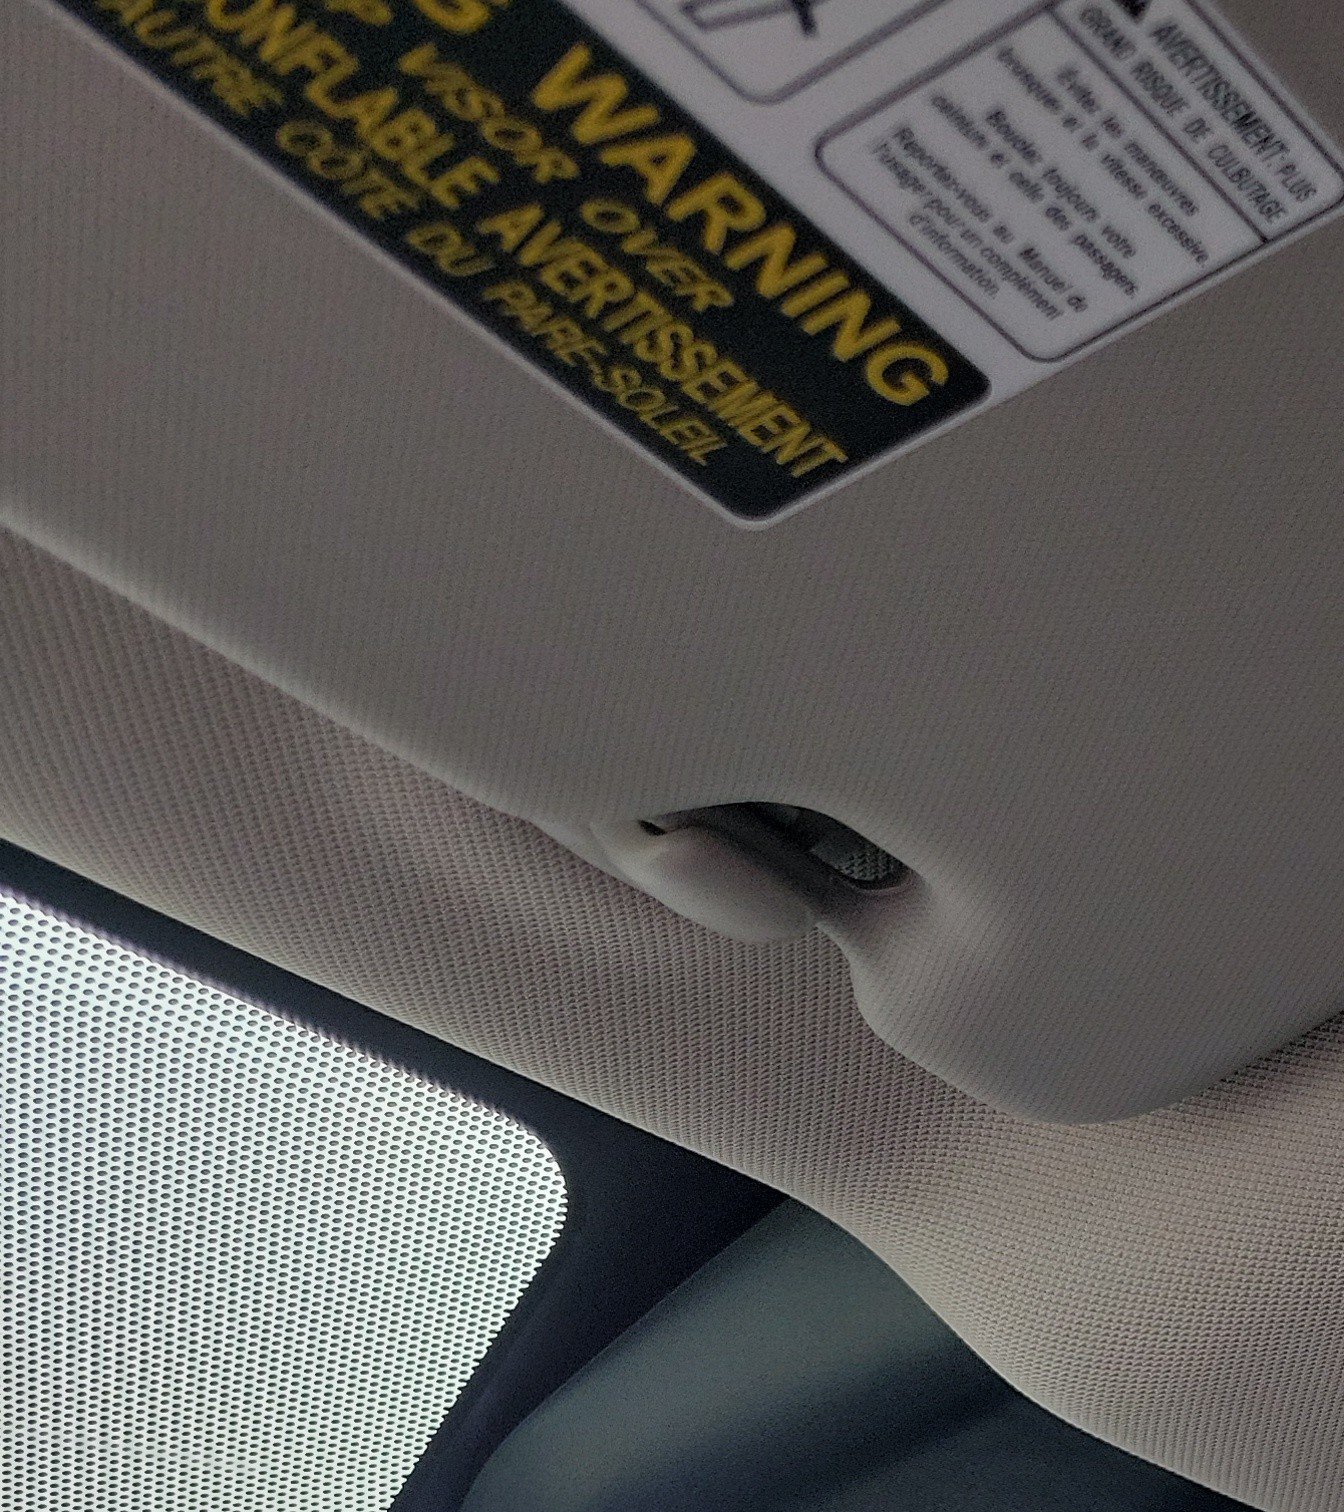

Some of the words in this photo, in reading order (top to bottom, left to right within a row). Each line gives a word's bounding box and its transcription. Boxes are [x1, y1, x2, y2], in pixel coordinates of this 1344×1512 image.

[401, 43, 579, 184] VISOR
[580, 199, 733, 310] OVER
[533, 42, 949, 406] WARNING
[1045, 206, 1070, 230] des
[1102, 224, 1136, 258] votre
[1130, 60, 1190, 116] RISQUE
[1184, 117, 1211, 142] DE
[1207, 144, 1287, 222] CULBUTAGE
[1276, 162, 1318, 202] PLUS
[406, 222, 495, 276] DU
[481, 282, 728, 465] PARE-SOLEIL
[476, 203, 848, 477] AVERTISSEMENT
